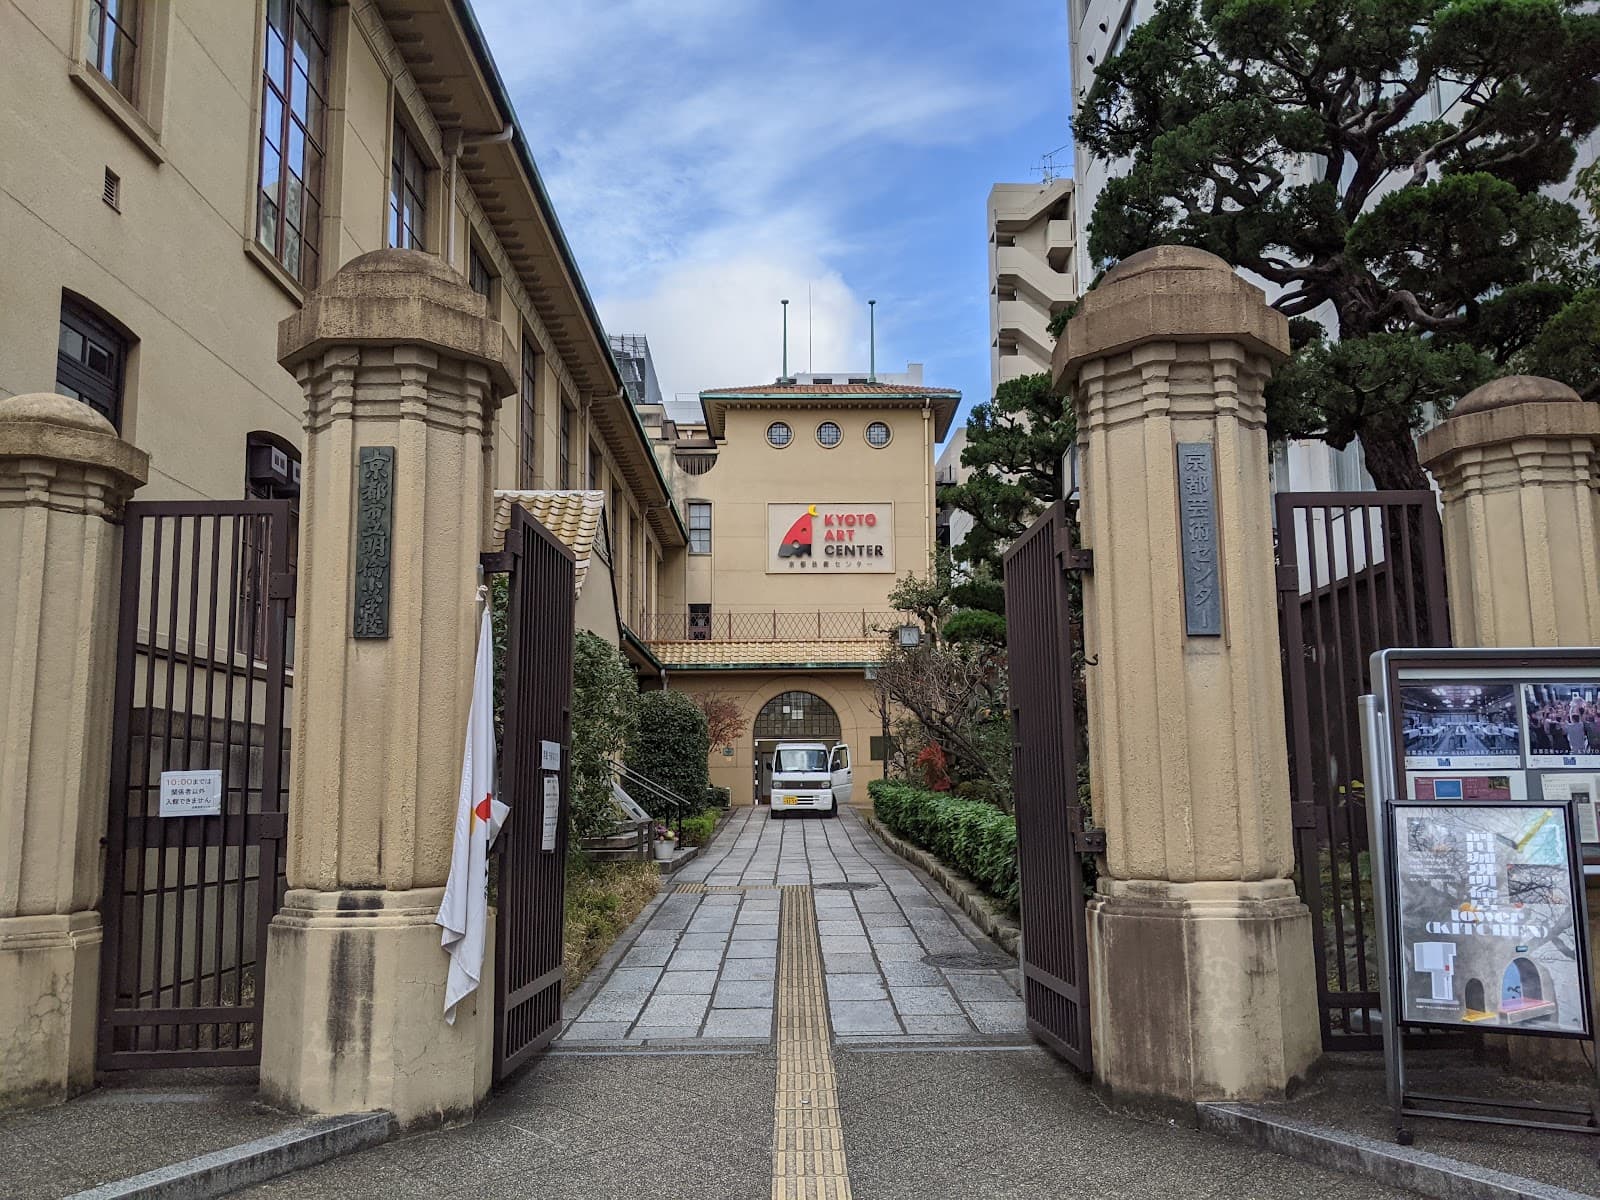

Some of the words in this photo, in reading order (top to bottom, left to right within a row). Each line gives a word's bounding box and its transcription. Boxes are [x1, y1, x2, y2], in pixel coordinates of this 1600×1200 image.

[824, 513, 877, 527] KYOTO
[824, 529, 855, 541] ART
[1183, 453, 1213, 629] 京都芸術センター
[824, 544, 884, 556] CENTER
